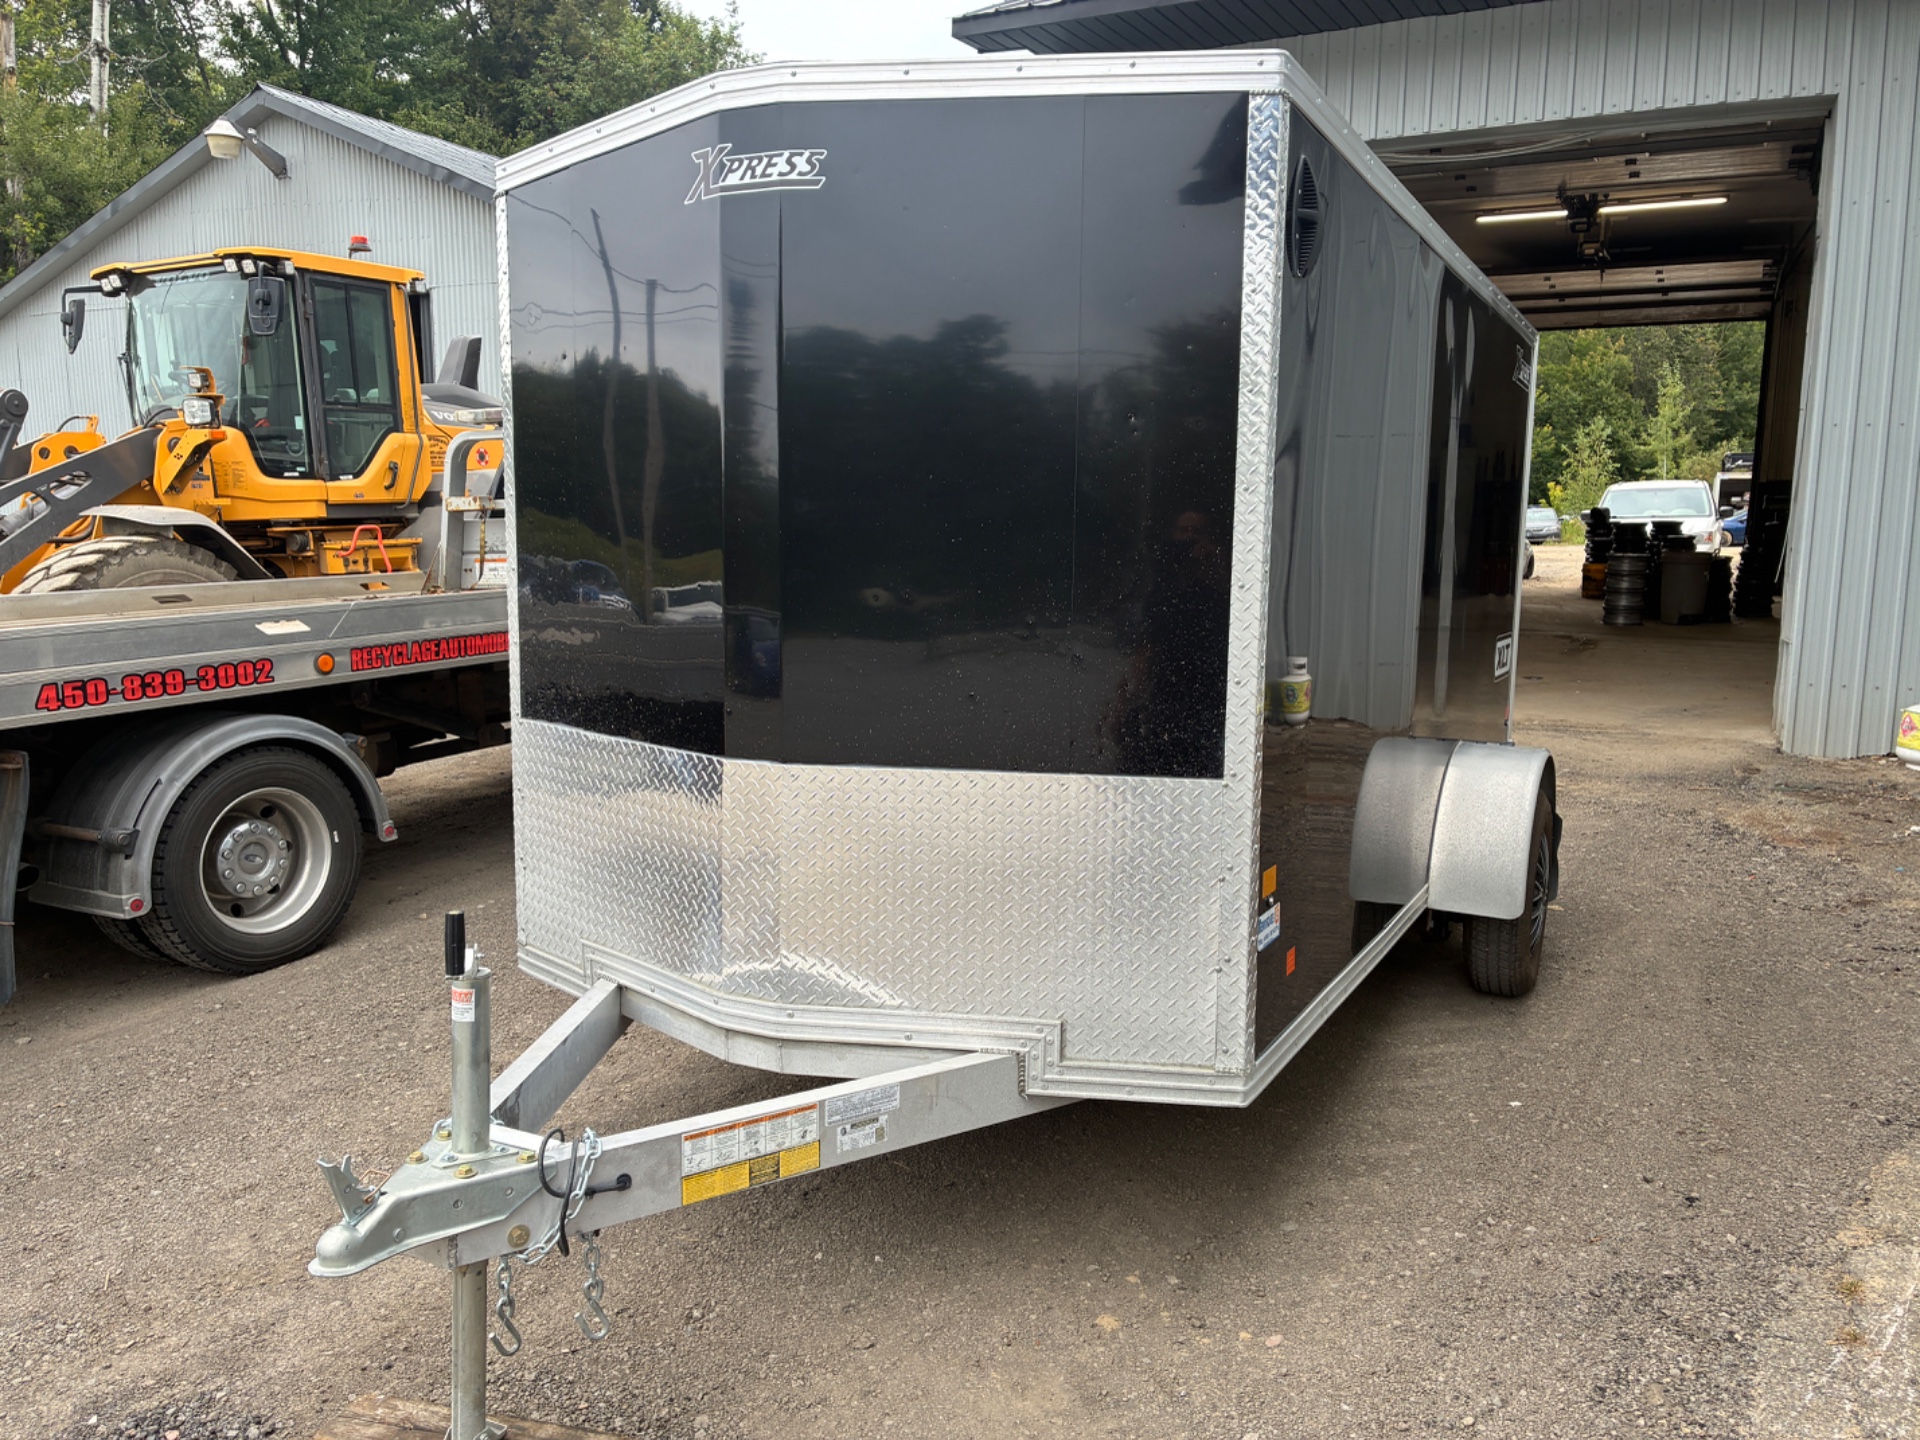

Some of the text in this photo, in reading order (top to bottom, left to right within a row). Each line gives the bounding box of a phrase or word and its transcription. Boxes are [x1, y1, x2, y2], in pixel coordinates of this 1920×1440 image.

[684, 143, 828, 205] XPRESS
[1496, 643, 1510, 671] XLT
[35, 658, 274, 711] 450-839-3002
